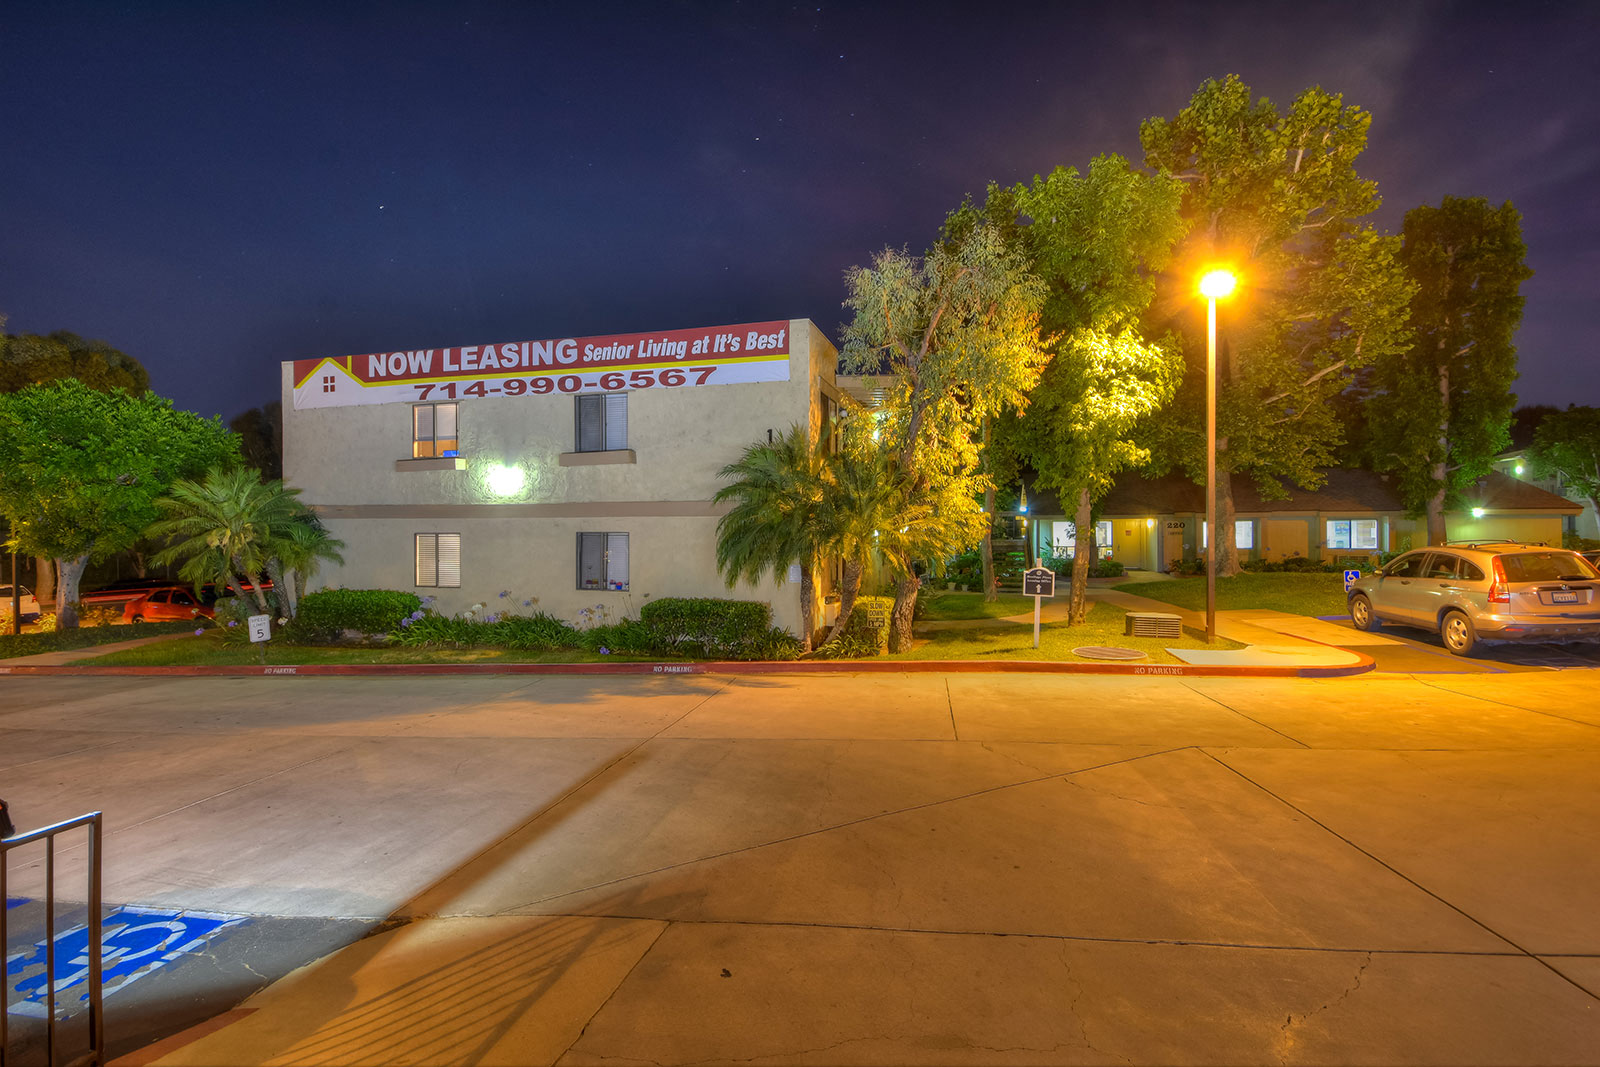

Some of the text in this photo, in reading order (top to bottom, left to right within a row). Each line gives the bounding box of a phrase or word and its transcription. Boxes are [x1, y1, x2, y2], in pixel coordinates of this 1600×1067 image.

[368, 329, 786, 378] NOW LEASING Senior Living at It's Best
[413, 365, 718, 401] 714-990-6567
[257, 628, 265, 639] 5
[1148, 667, 1183, 675] PARKING
